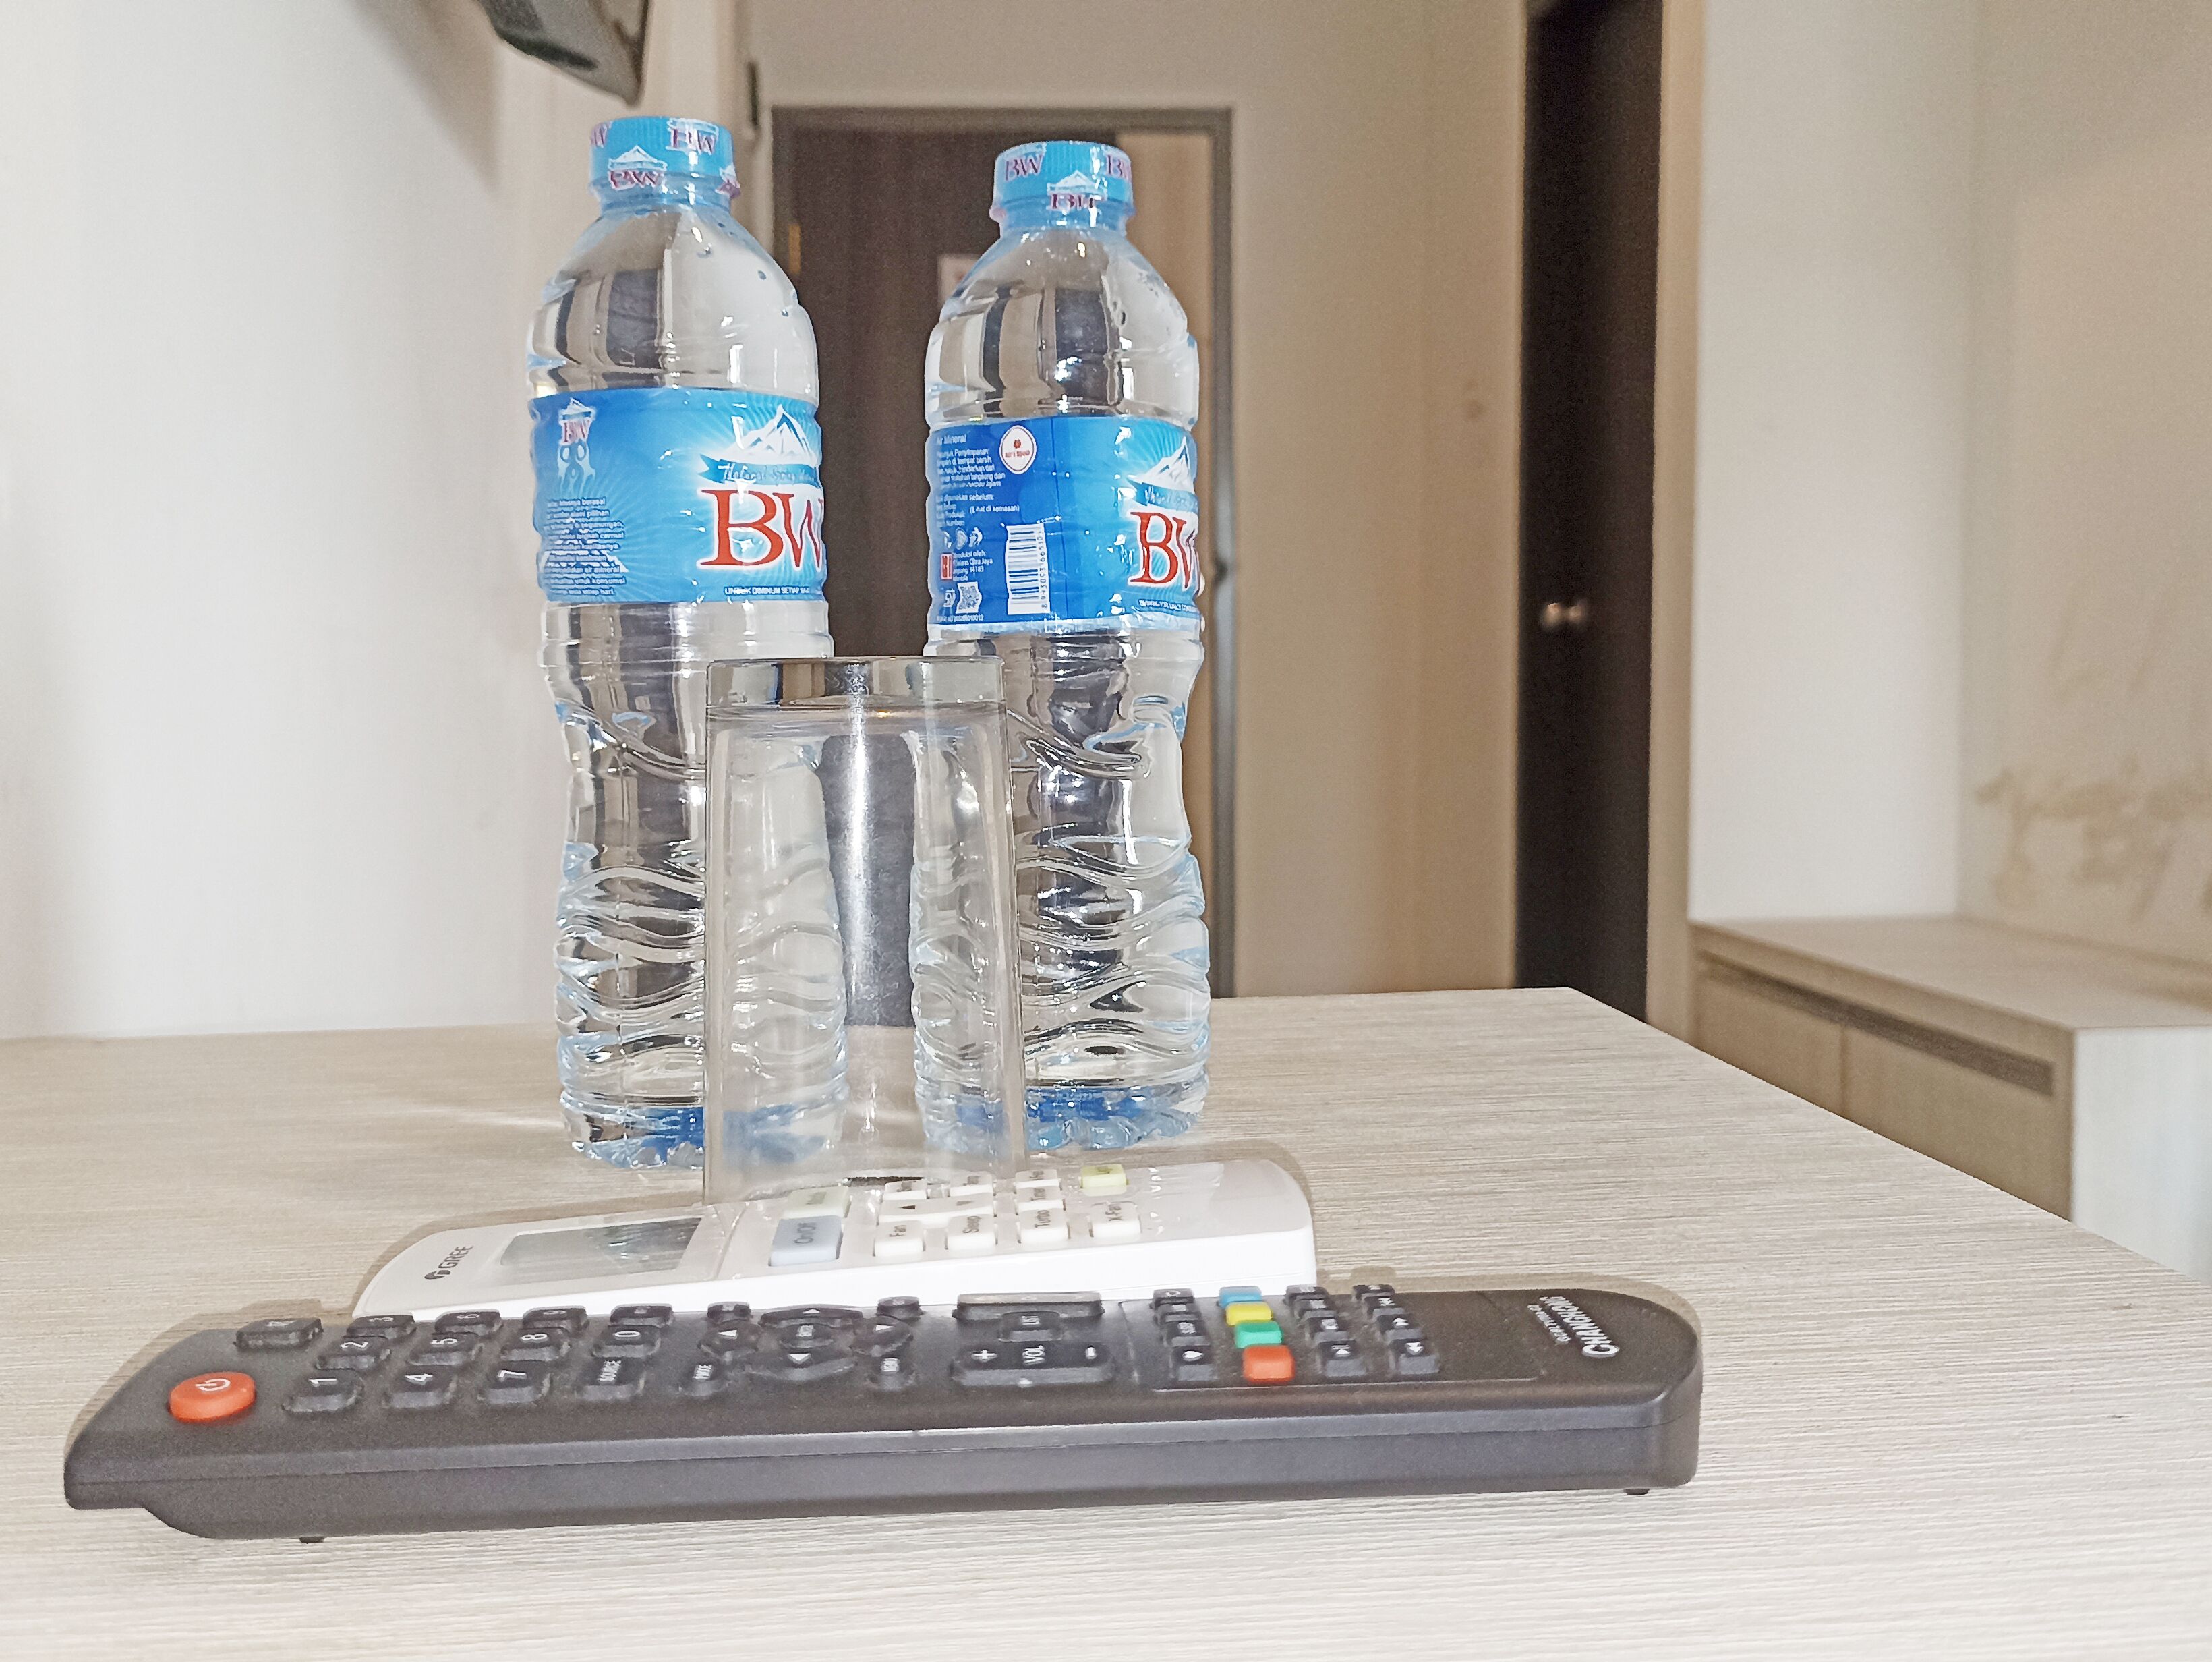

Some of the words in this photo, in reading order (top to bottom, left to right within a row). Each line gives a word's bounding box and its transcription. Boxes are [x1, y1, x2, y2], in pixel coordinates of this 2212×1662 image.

[1005, 154, 1043, 181] BW
[701, 490, 823, 567] BW
[438, 1245, 474, 1269] GREE
[1539, 1296, 1620, 1356] CHANGHONG
[520, 1333, 548, 1341] 8
[1022, 1344, 1045, 1364] VOL
[309, 1377, 337, 1385] 1
[405, 1373, 433, 1382] 4
[498, 1369, 527, 1378] 7
